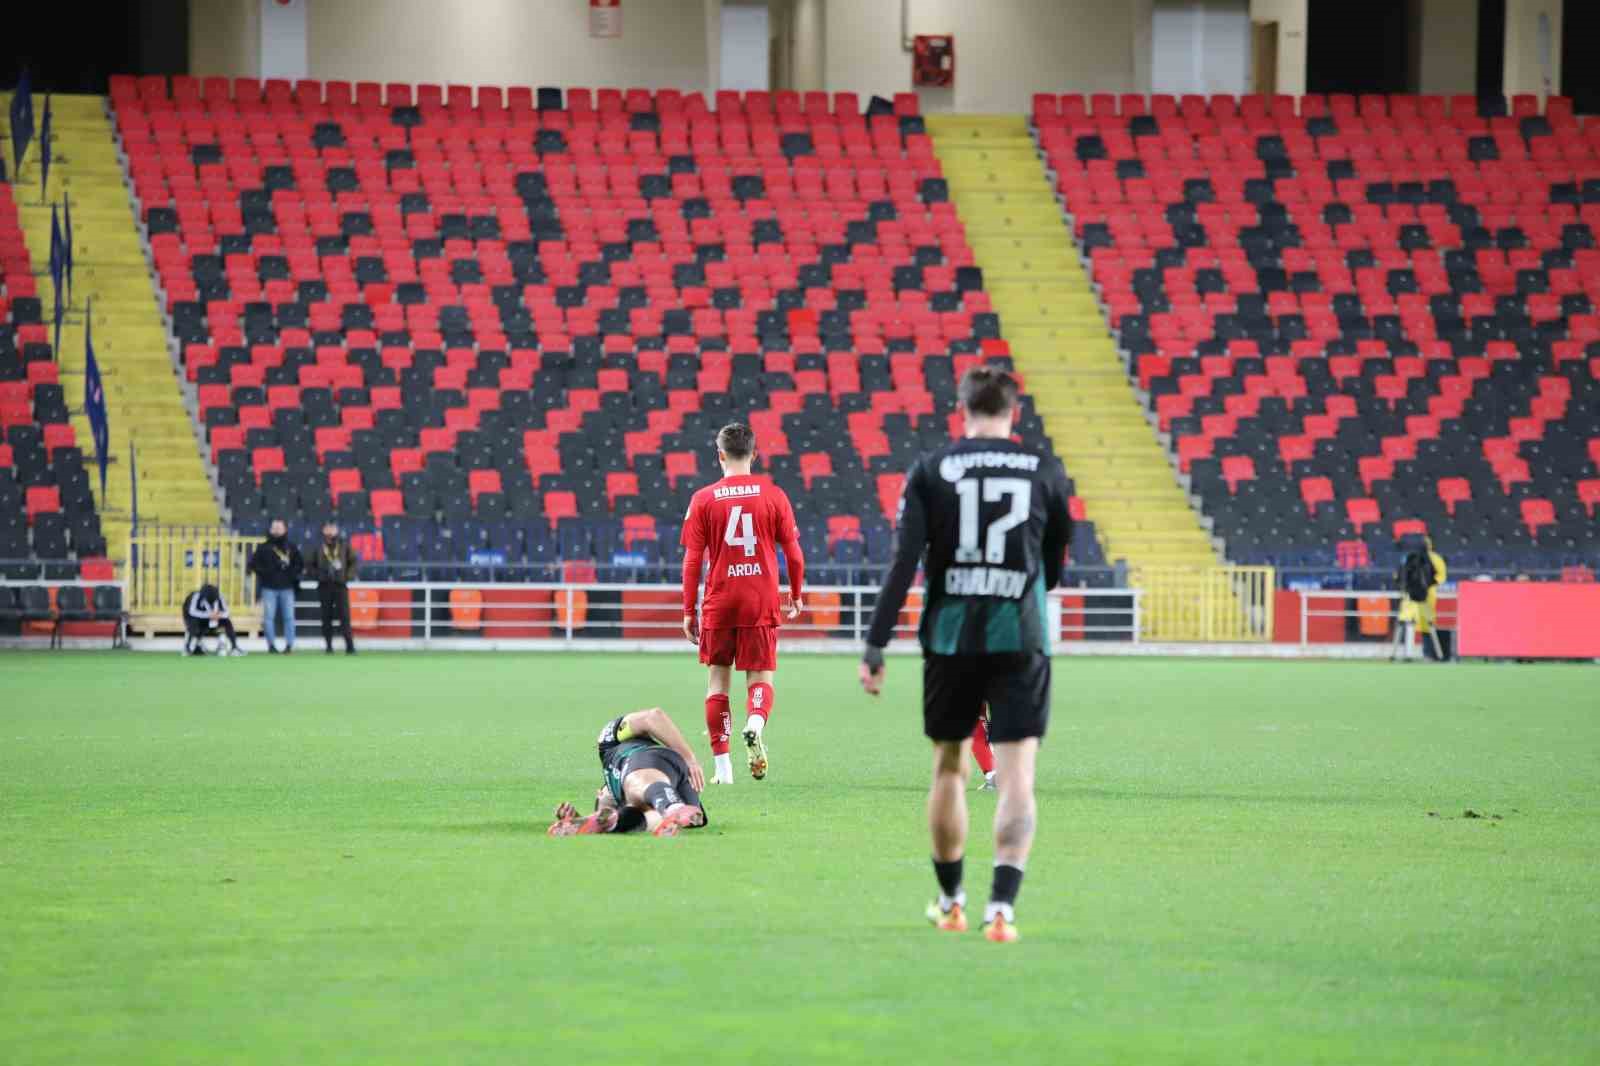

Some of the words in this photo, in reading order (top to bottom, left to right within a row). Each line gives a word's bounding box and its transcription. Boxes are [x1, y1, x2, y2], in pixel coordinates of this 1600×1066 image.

[724, 505, 757, 557] 4
[955, 477, 1032, 564] 17
[727, 563, 762, 577] ARDA
